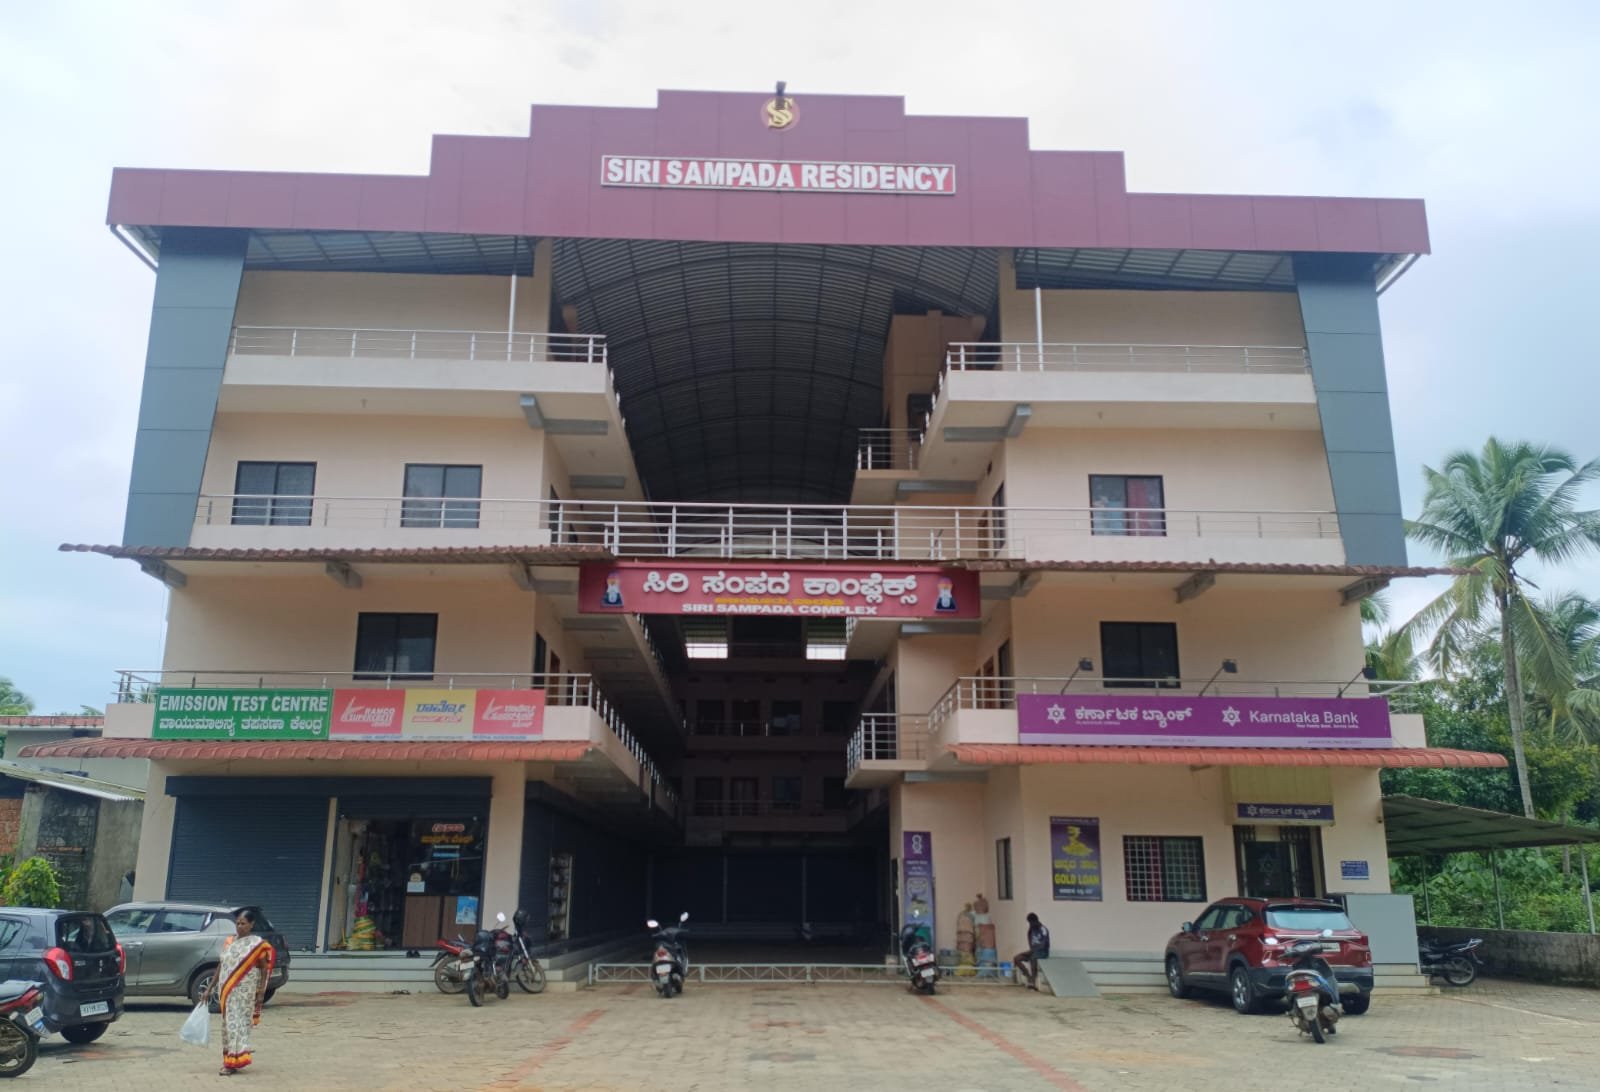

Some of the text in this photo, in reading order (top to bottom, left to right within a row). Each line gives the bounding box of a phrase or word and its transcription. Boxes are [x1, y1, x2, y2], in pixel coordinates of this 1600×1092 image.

[607, 157, 951, 192] SIRI SAMPADA RESIDENCY
[643, 570, 918, 604] ಸಿರಿ ಸಂಪದ ಕಾಂಪ್ಲೆಕ್ಸ್
[682, 603, 878, 615] SIRI SAMPADA COMPLEX
[159, 695, 328, 712] EMISSION TEST CENTRE
[1075, 707, 1193, 729] ಕರ್ನಾಟಕ ಬ್ಯಾಂಕ್
[1249, 710, 1359, 724] Karnataka Bank
[1055, 873, 1100, 885] GOLD LOAN
